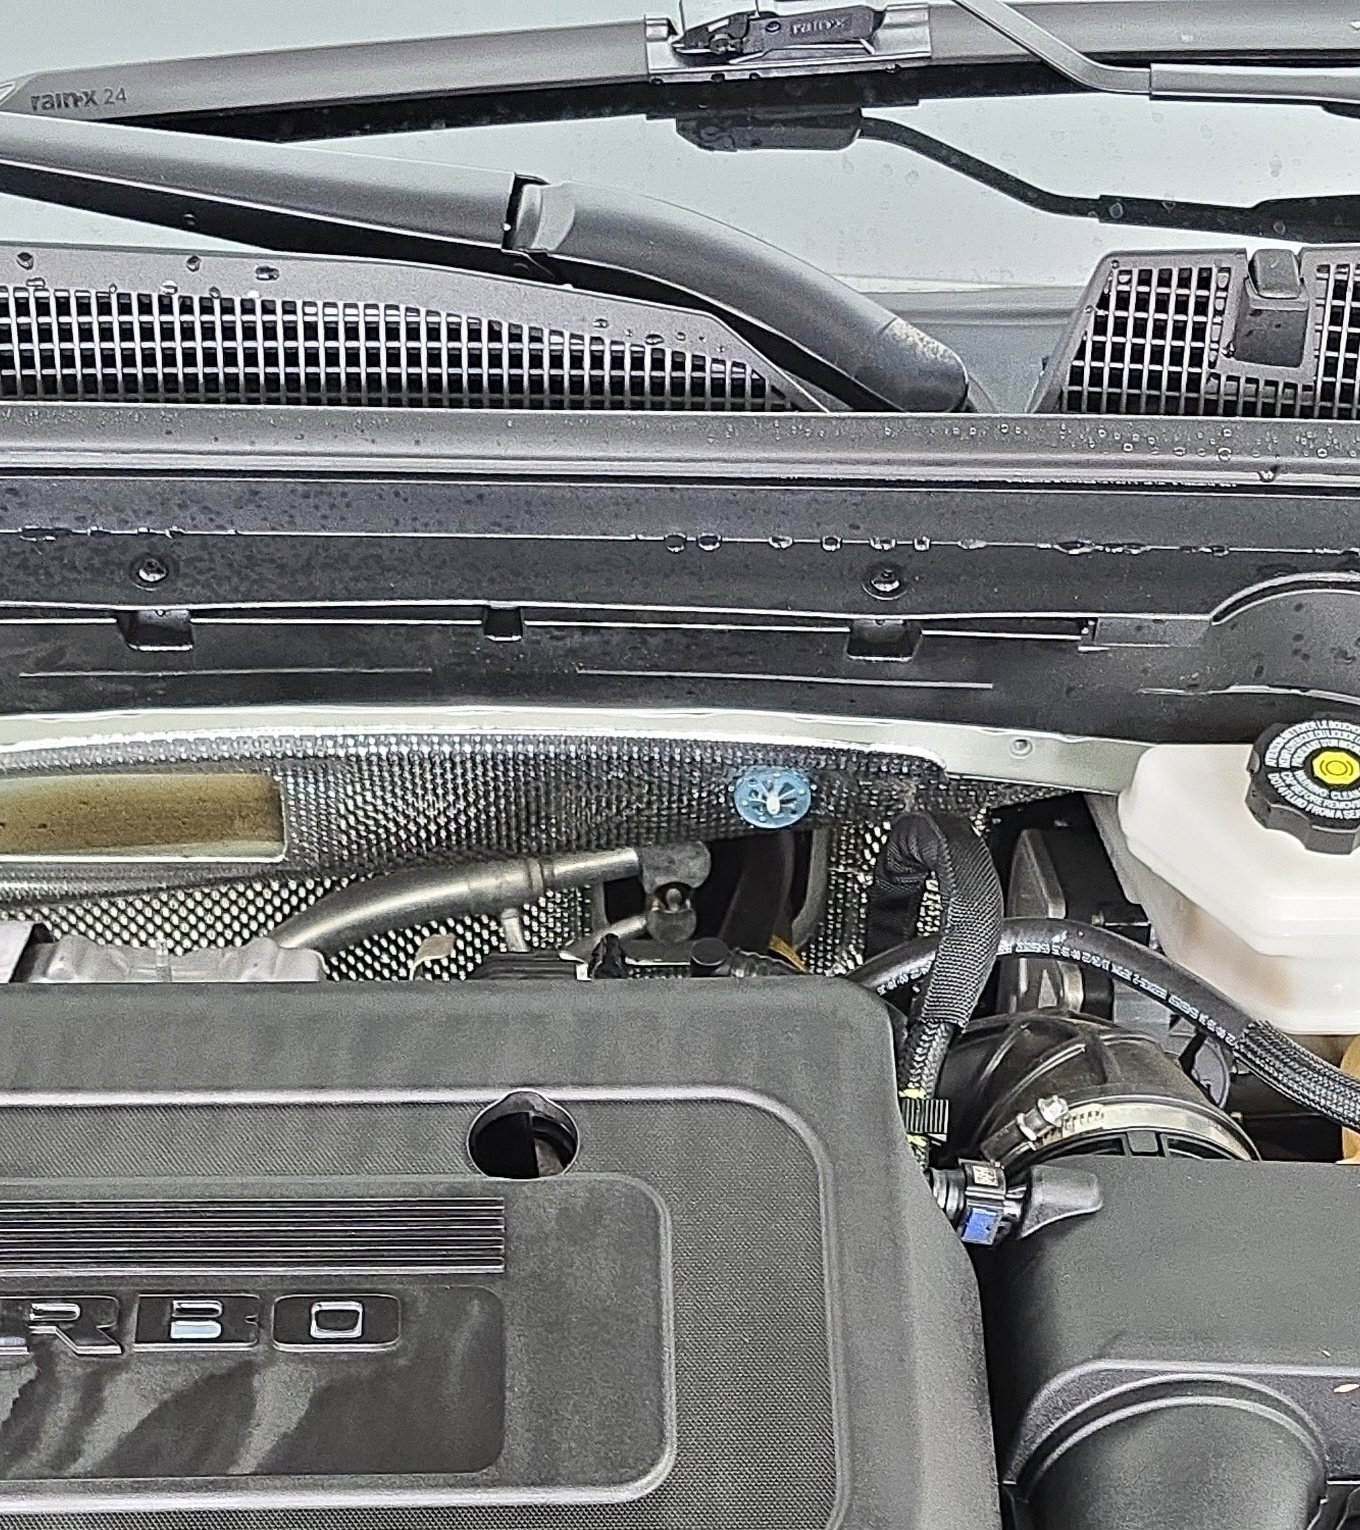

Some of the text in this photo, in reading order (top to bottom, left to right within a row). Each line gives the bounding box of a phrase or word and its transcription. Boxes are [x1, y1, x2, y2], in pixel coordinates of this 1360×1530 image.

[103, 87, 127, 105] 24
[1280, 789, 1308, 808] FLUID
[1305, 803, 1337, 818] FROM
